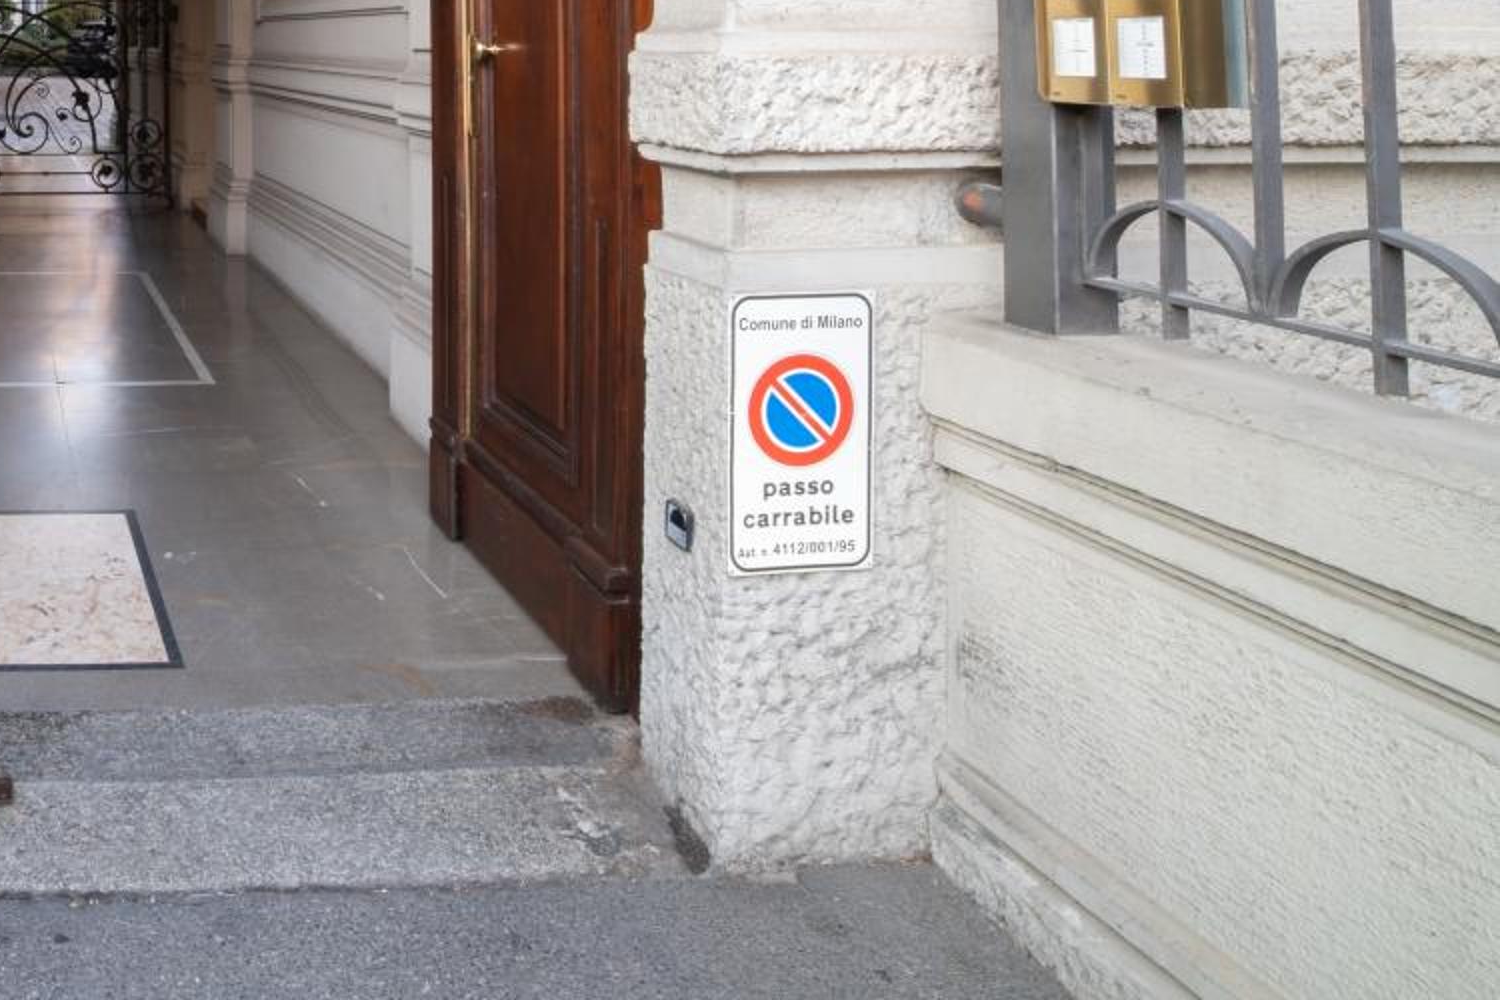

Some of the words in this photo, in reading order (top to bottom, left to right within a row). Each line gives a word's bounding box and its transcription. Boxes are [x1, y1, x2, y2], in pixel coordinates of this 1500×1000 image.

[739, 317, 797, 331] Comune
[801, 315, 813, 329] di
[817, 314, 863, 329] Milano
[763, 480, 834, 501] passo
[743, 504, 855, 529] carrabile
